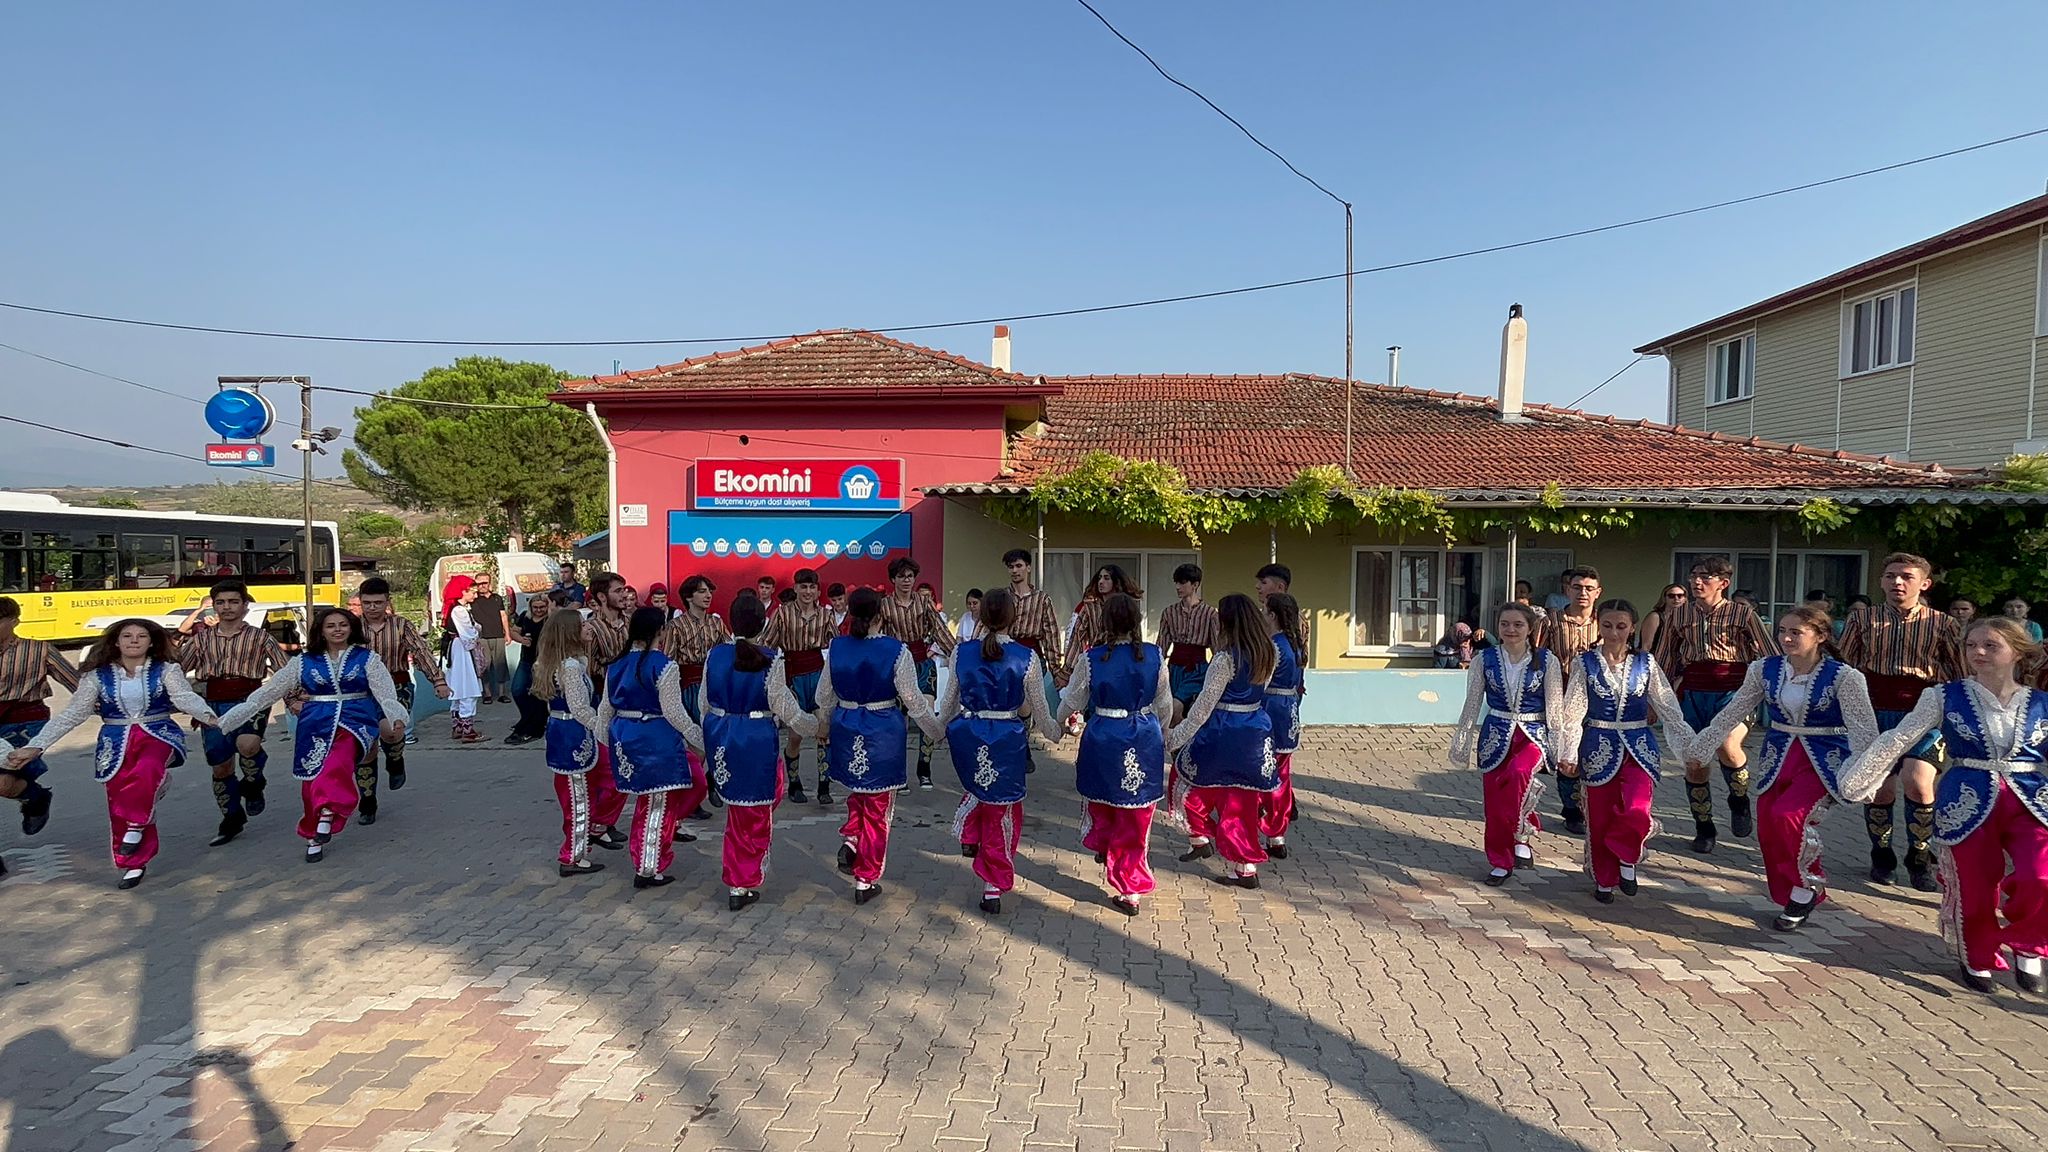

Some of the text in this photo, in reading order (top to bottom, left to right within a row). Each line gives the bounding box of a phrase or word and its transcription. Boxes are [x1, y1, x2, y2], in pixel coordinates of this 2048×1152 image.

[209, 450, 242, 459] Ekomini
[714, 468, 811, 493] Ekomini
[745, 499, 767, 507] uygun
[767, 497, 782, 506] dost
